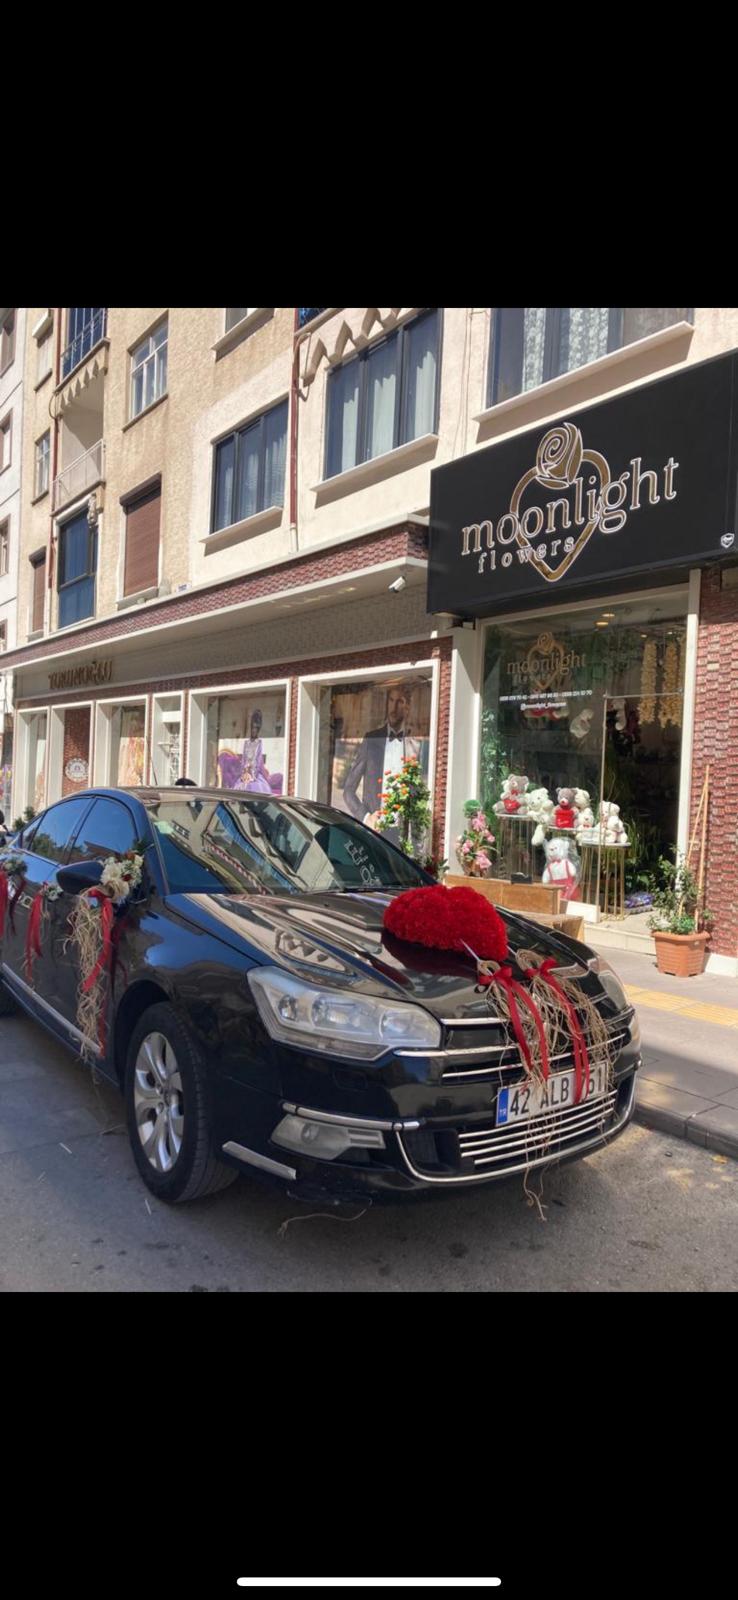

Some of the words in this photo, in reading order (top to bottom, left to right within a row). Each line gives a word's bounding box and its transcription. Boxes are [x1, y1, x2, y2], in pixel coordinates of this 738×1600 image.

[461, 457, 680, 556] moonlight
[478, 536, 576, 574] flowers
[507, 650, 587, 676] moonlight
[510, 1089, 530, 1116] 42
[540, 1077, 570, 1108] ALB
